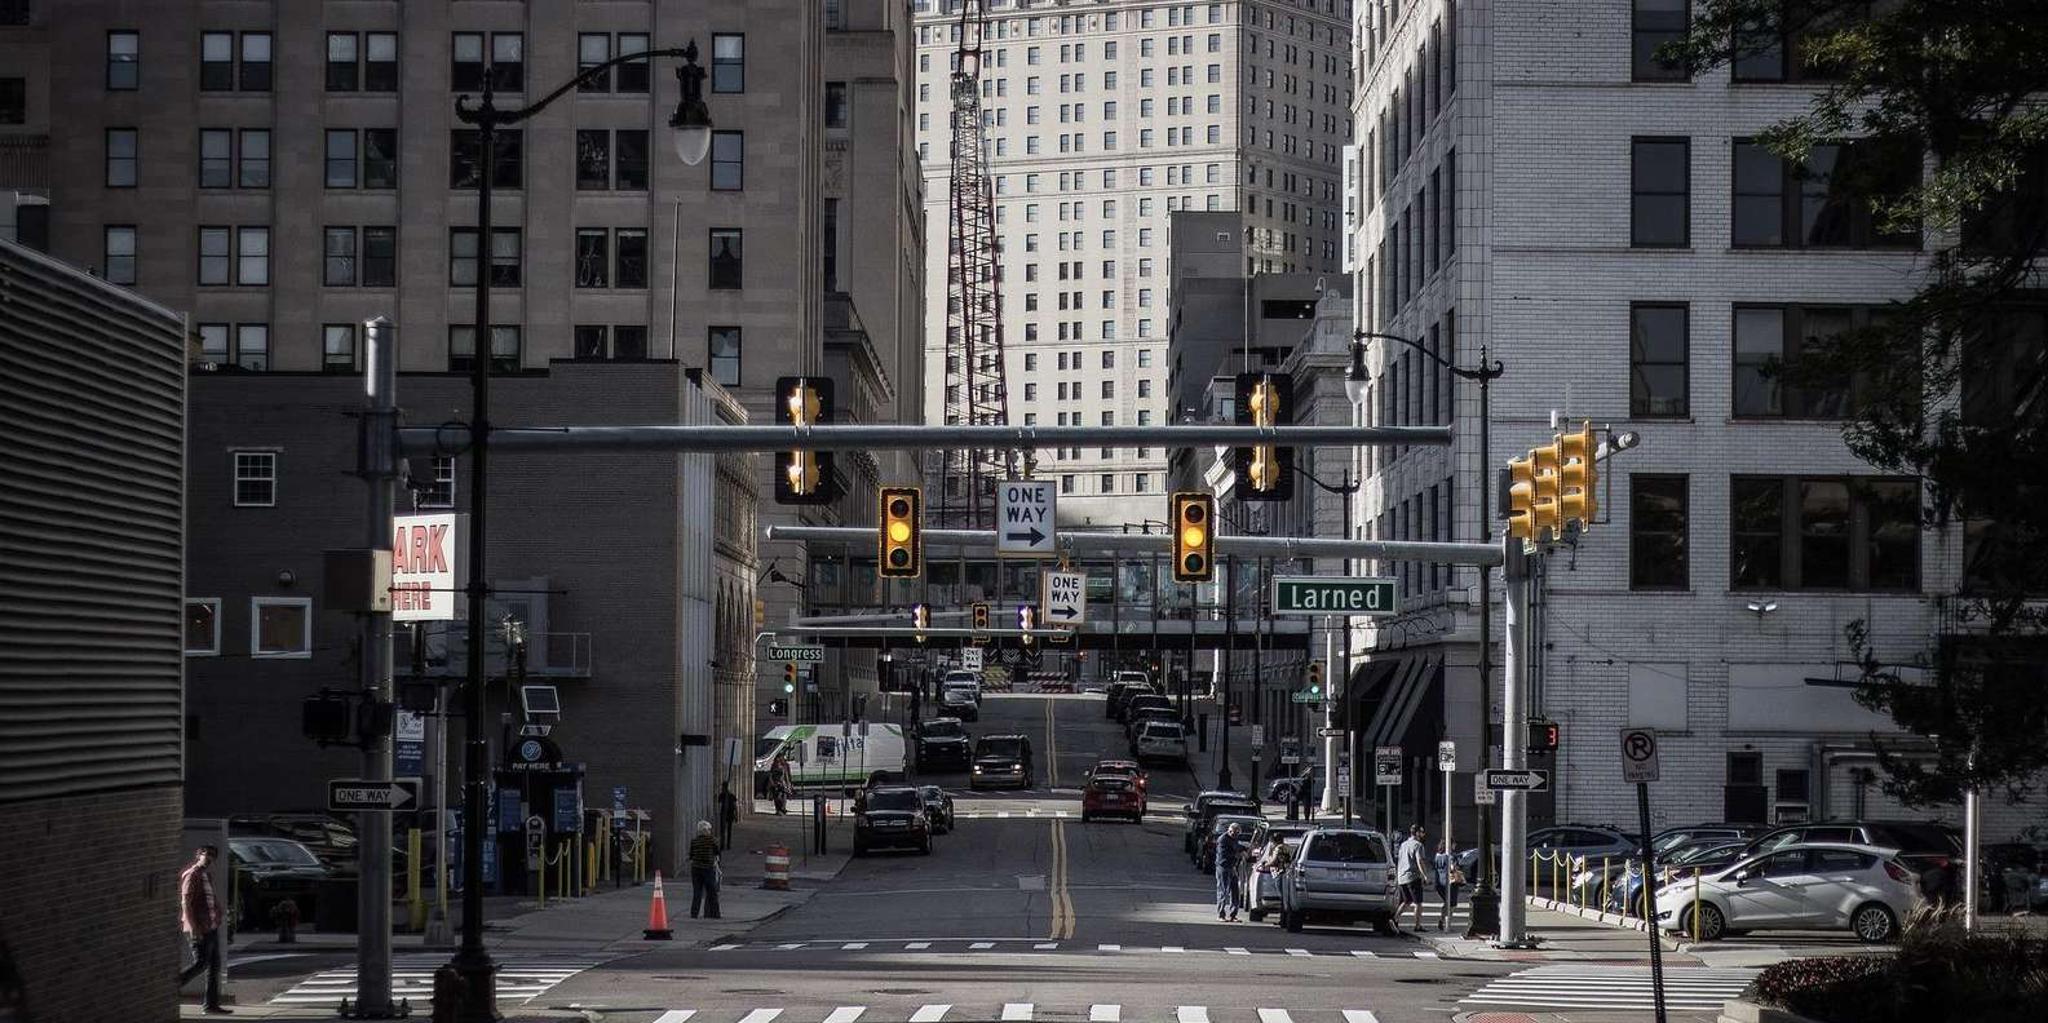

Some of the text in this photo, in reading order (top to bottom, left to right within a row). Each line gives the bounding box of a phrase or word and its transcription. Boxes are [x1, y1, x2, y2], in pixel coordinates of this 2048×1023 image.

[1007, 487, 1045, 503] ONE
[1006, 507, 1047, 523] WAY
[393, 524, 449, 574] ARK
[1052, 576, 1080, 589] ONE
[1051, 590, 1080, 603] WAY
[1291, 584, 1380, 609] Larned
[769, 647, 821, 661] Congress
[1493, 775, 1529, 785] ONE WAY
[339, 790, 391, 801] ONE WAY
